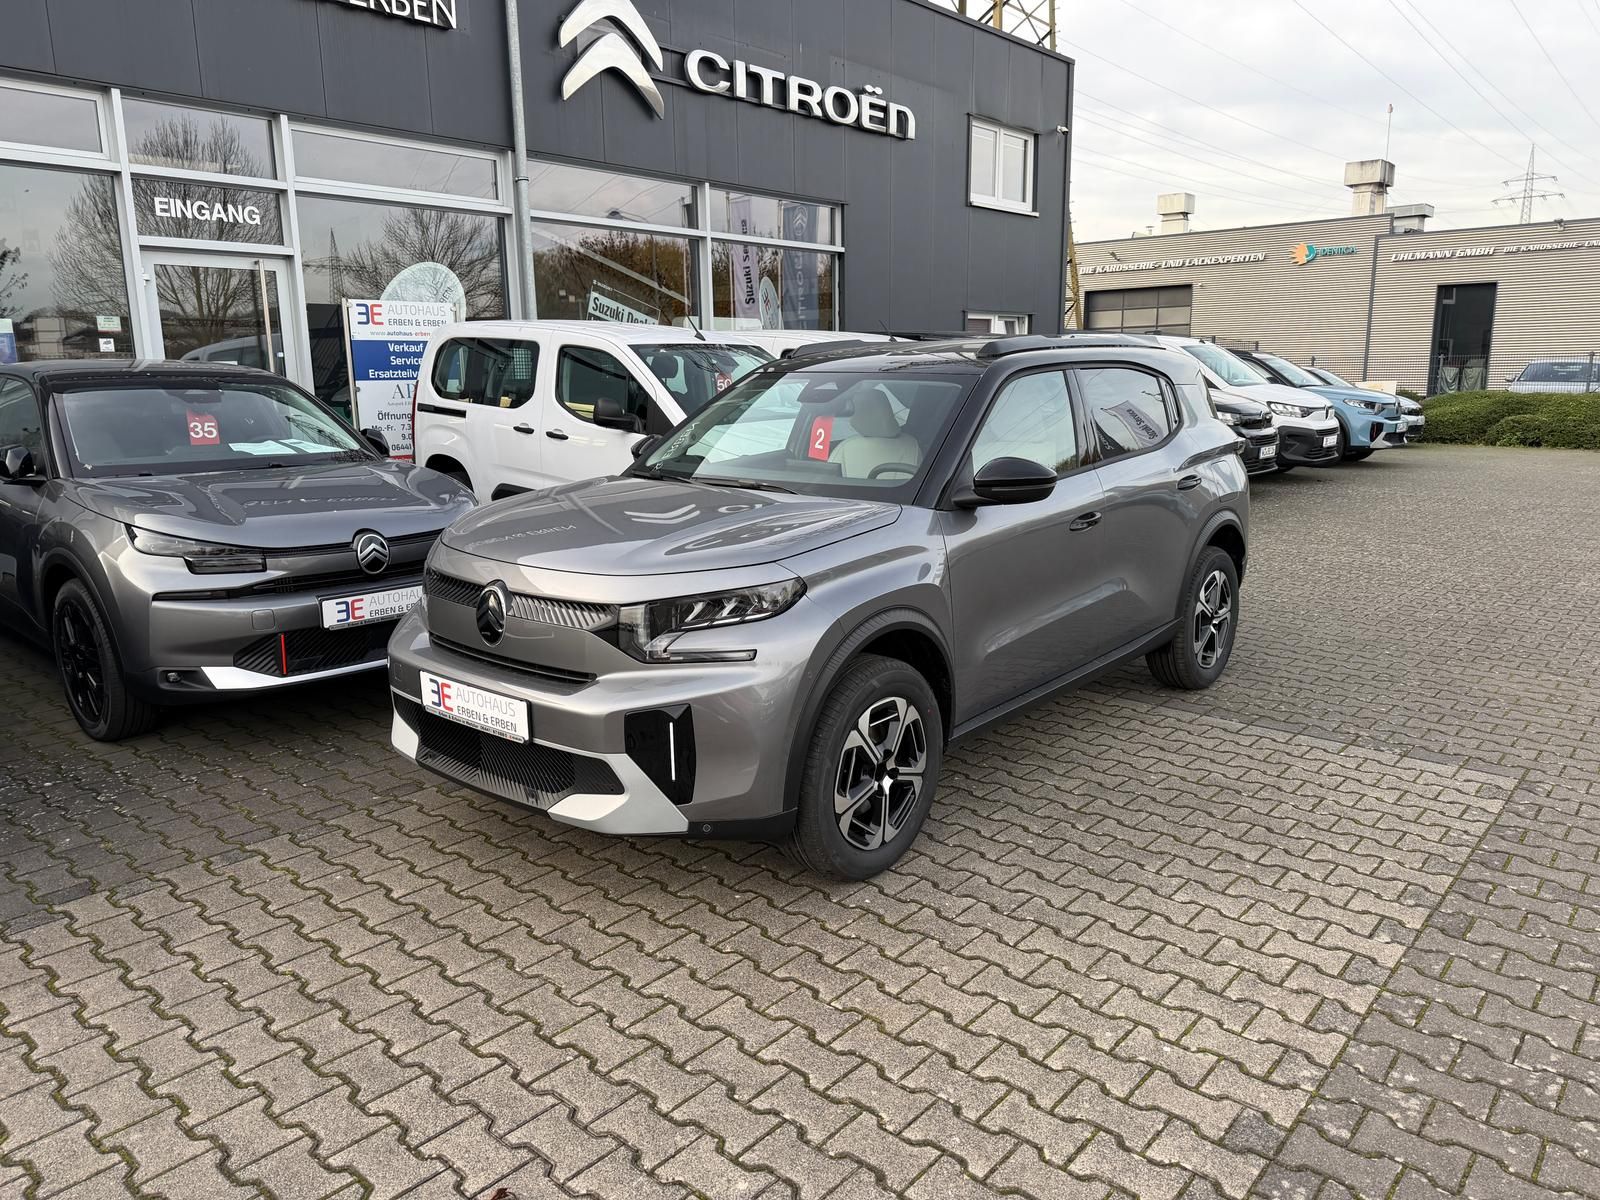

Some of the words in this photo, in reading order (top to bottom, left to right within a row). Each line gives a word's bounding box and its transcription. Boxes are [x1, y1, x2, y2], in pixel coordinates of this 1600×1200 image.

[684, 49, 916, 140] CITROËN
[154, 196, 261, 226] EINGANG
[1080, 266, 1096, 276] DIE
[1162, 259, 1184, 269] UND
[1185, 252, 1266, 267] LACKEXPERTEN
[1391, 249, 1452, 262] UHLMANN
[743, 265, 755, 305] Suzuki
[388, 304, 447, 317] AUTOHAUS
[592, 296, 625, 323] Suzuki
[388, 318, 413, 327] ERBEN
[415, 318, 421, 327] &
[387, 342, 424, 352] Verkauf
[368, 369, 418, 378] Ersatzteilv
[377, 410, 413, 422] Öffnung
[188, 421, 218, 439] 35
[815, 428, 825, 450] 2
[369, 589, 421, 607] AUTOHAU
[369, 605, 396, 618] ERBEN
[398, 605, 404, 613] &
[456, 687, 516, 717] AUTOHAUS
[457, 705, 481, 721] ERBEN
[482, 713, 489, 723] &
[490, 716, 517, 733] ERBEN
